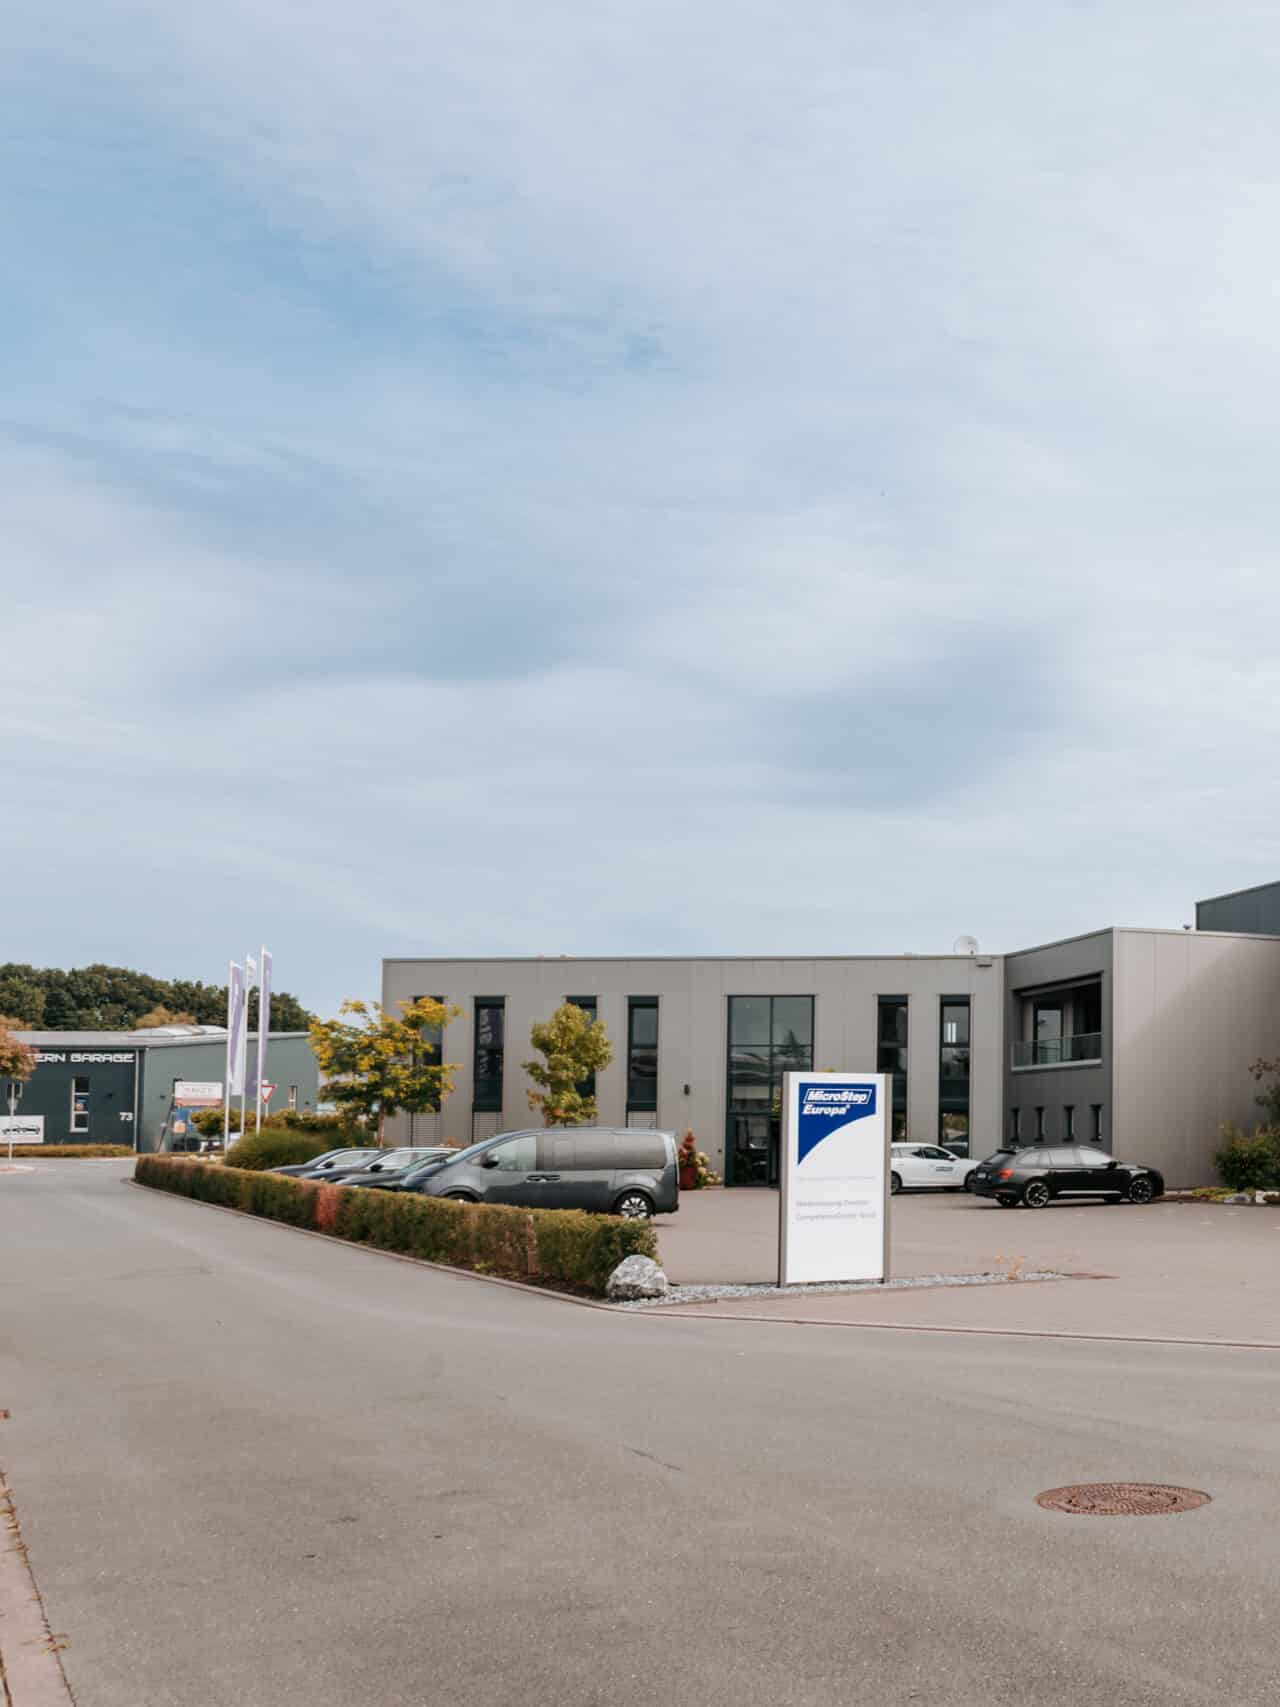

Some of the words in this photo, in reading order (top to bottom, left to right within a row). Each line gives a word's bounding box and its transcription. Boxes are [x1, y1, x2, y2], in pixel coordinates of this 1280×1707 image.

[70, 1053, 135, 1063] GARAGE
[807, 1090, 868, 1104] MicroStep
[119, 1111, 134, 1121] 73
